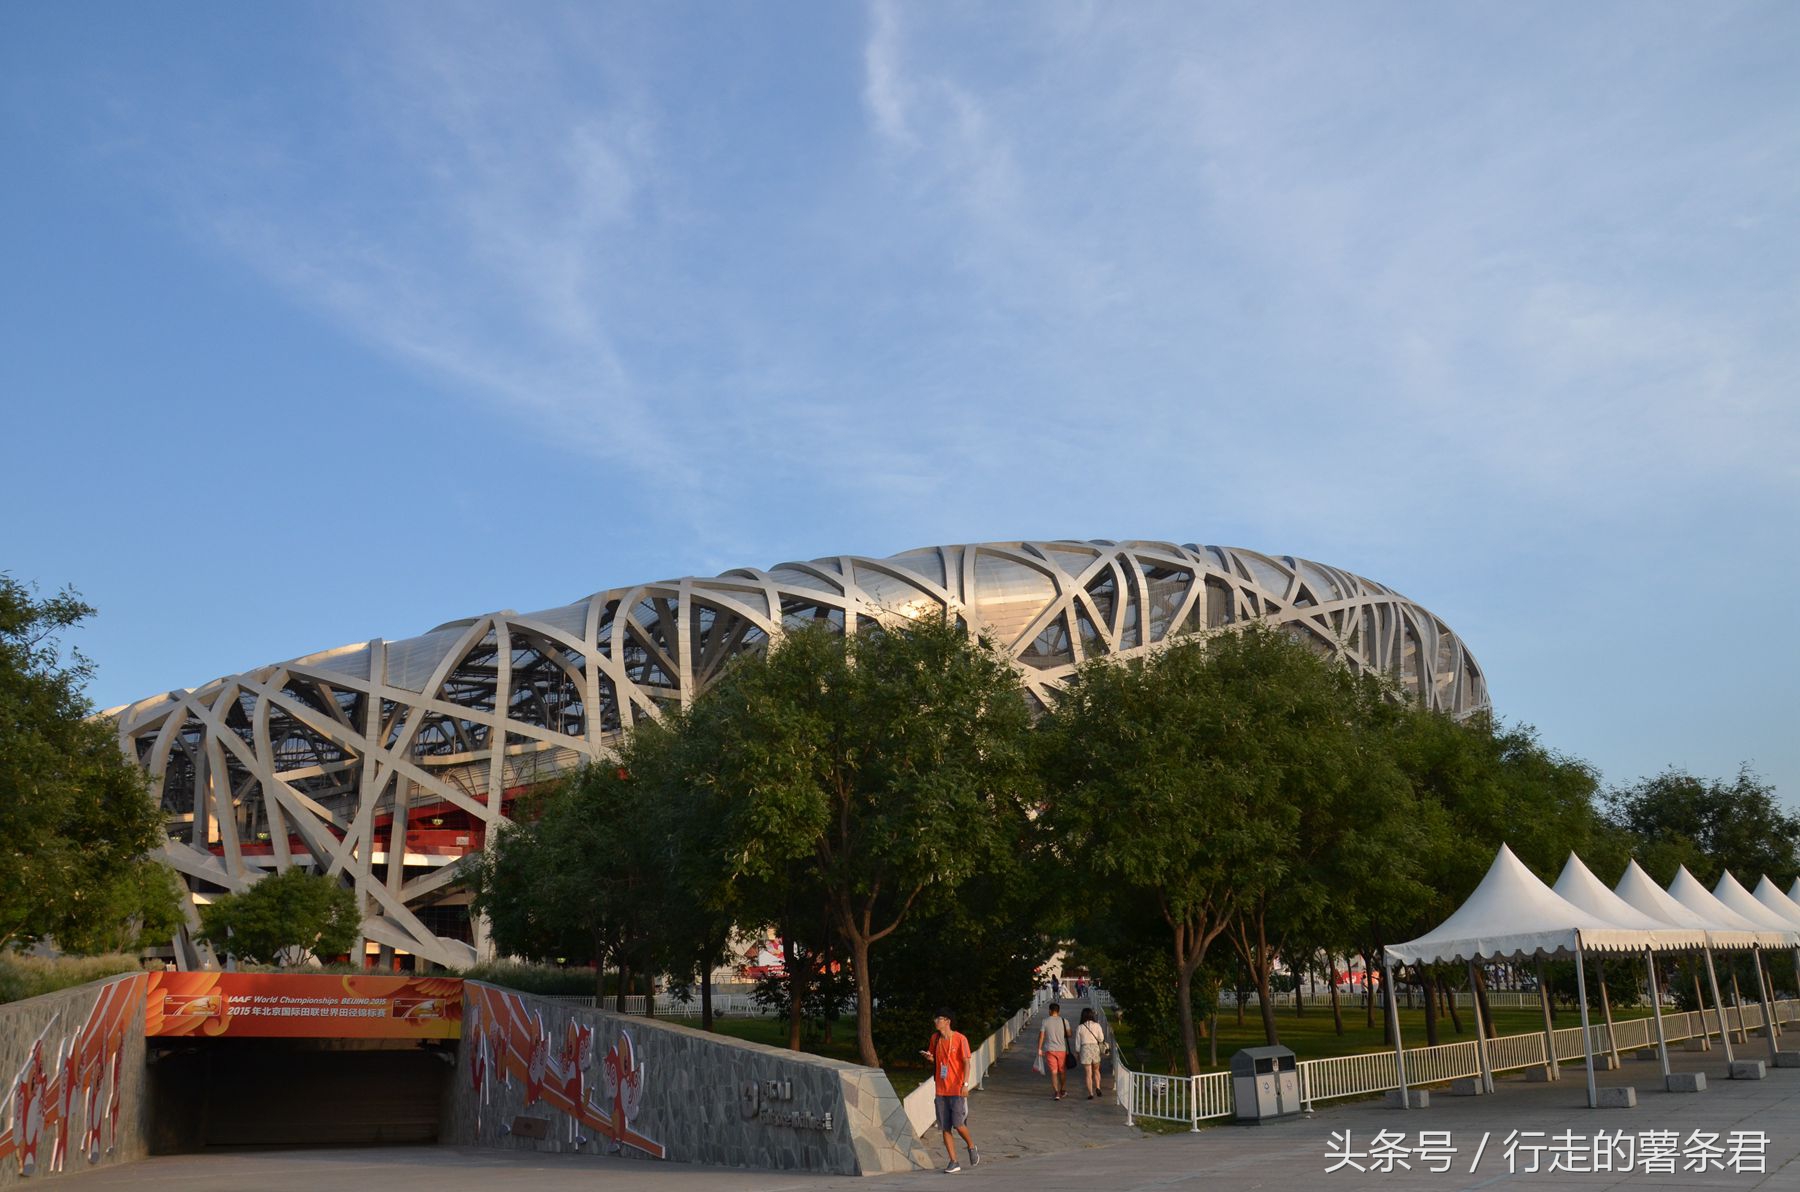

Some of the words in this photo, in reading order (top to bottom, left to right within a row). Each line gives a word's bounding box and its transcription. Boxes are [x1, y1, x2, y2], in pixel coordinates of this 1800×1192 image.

[228, 995, 252, 1004] IAAF
[253, 995, 279, 1004] World
[279, 995, 339, 1006] Championships
[341, 997, 370, 1005] BEIJING
